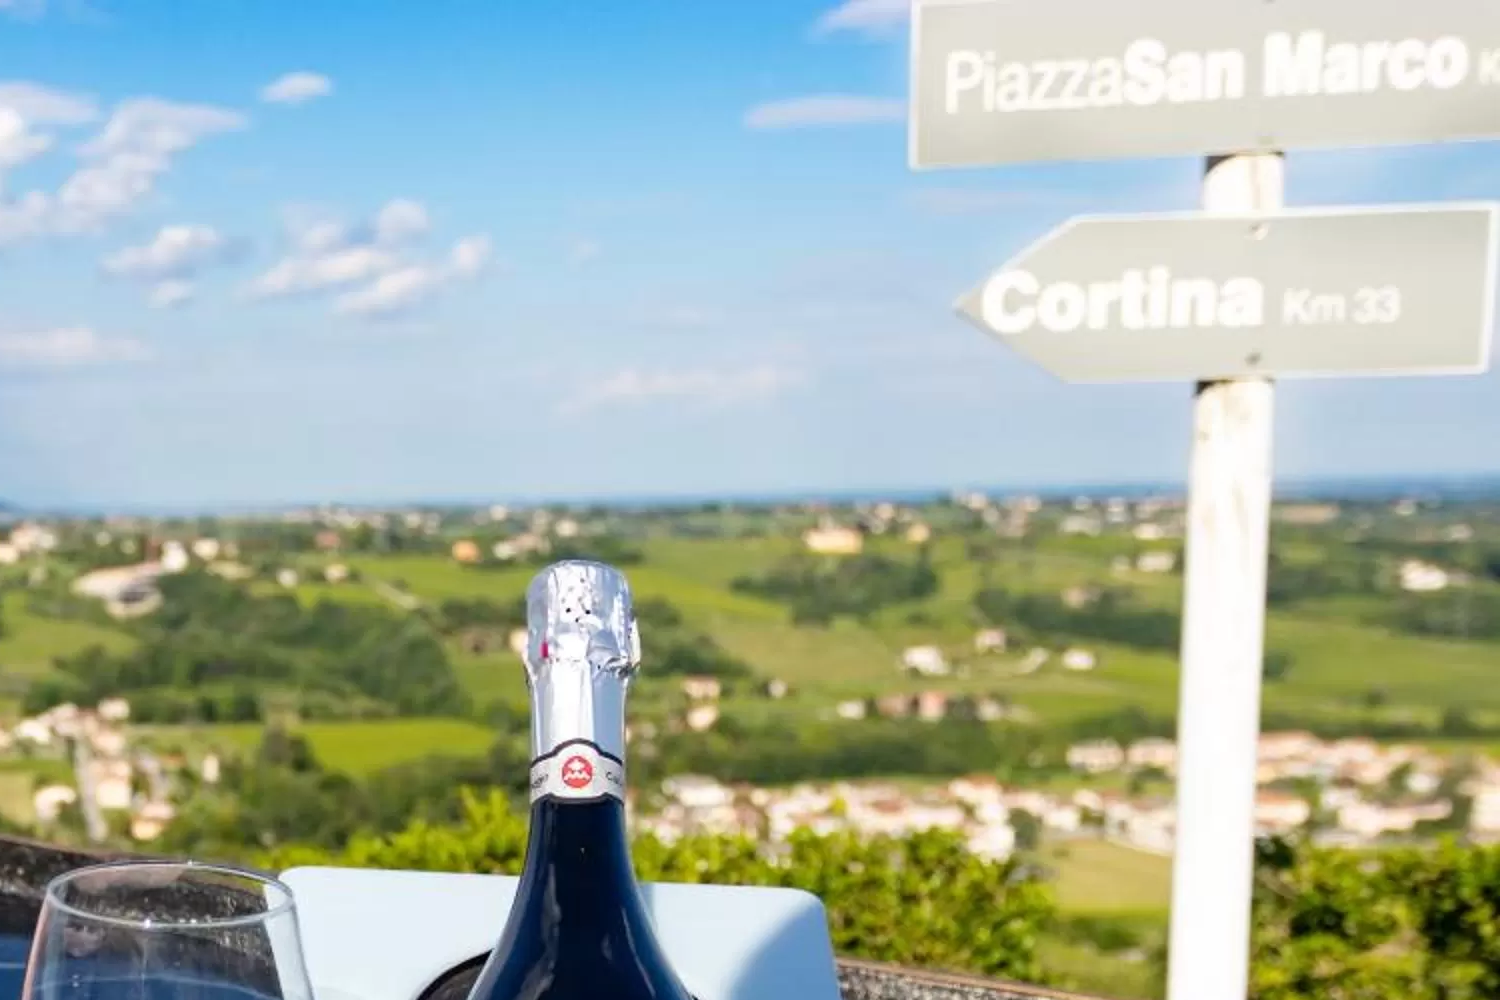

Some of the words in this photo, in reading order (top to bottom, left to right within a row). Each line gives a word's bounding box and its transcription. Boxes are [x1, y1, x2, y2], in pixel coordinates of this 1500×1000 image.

[1263, 30, 1469, 97] Marco
[981, 267, 1263, 334] Cortina
[1283, 288, 1346, 325] Km
[1352, 285, 1401, 324] 33
